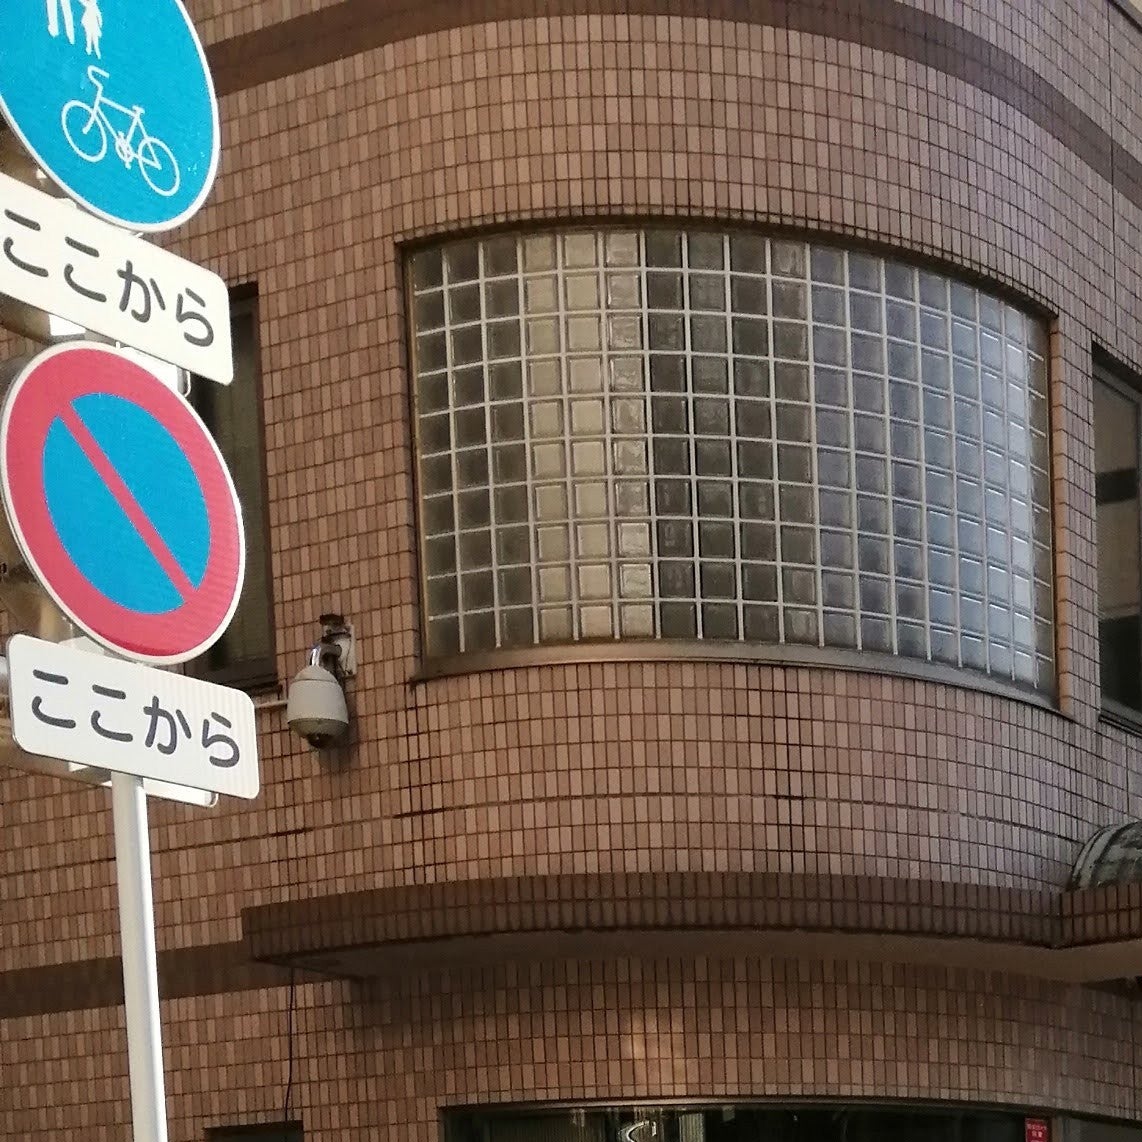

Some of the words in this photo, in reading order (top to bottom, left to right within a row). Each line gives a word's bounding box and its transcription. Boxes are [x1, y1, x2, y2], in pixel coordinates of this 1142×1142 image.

[3, 208, 214, 348] ここから
[32, 668, 241, 768] ここから
